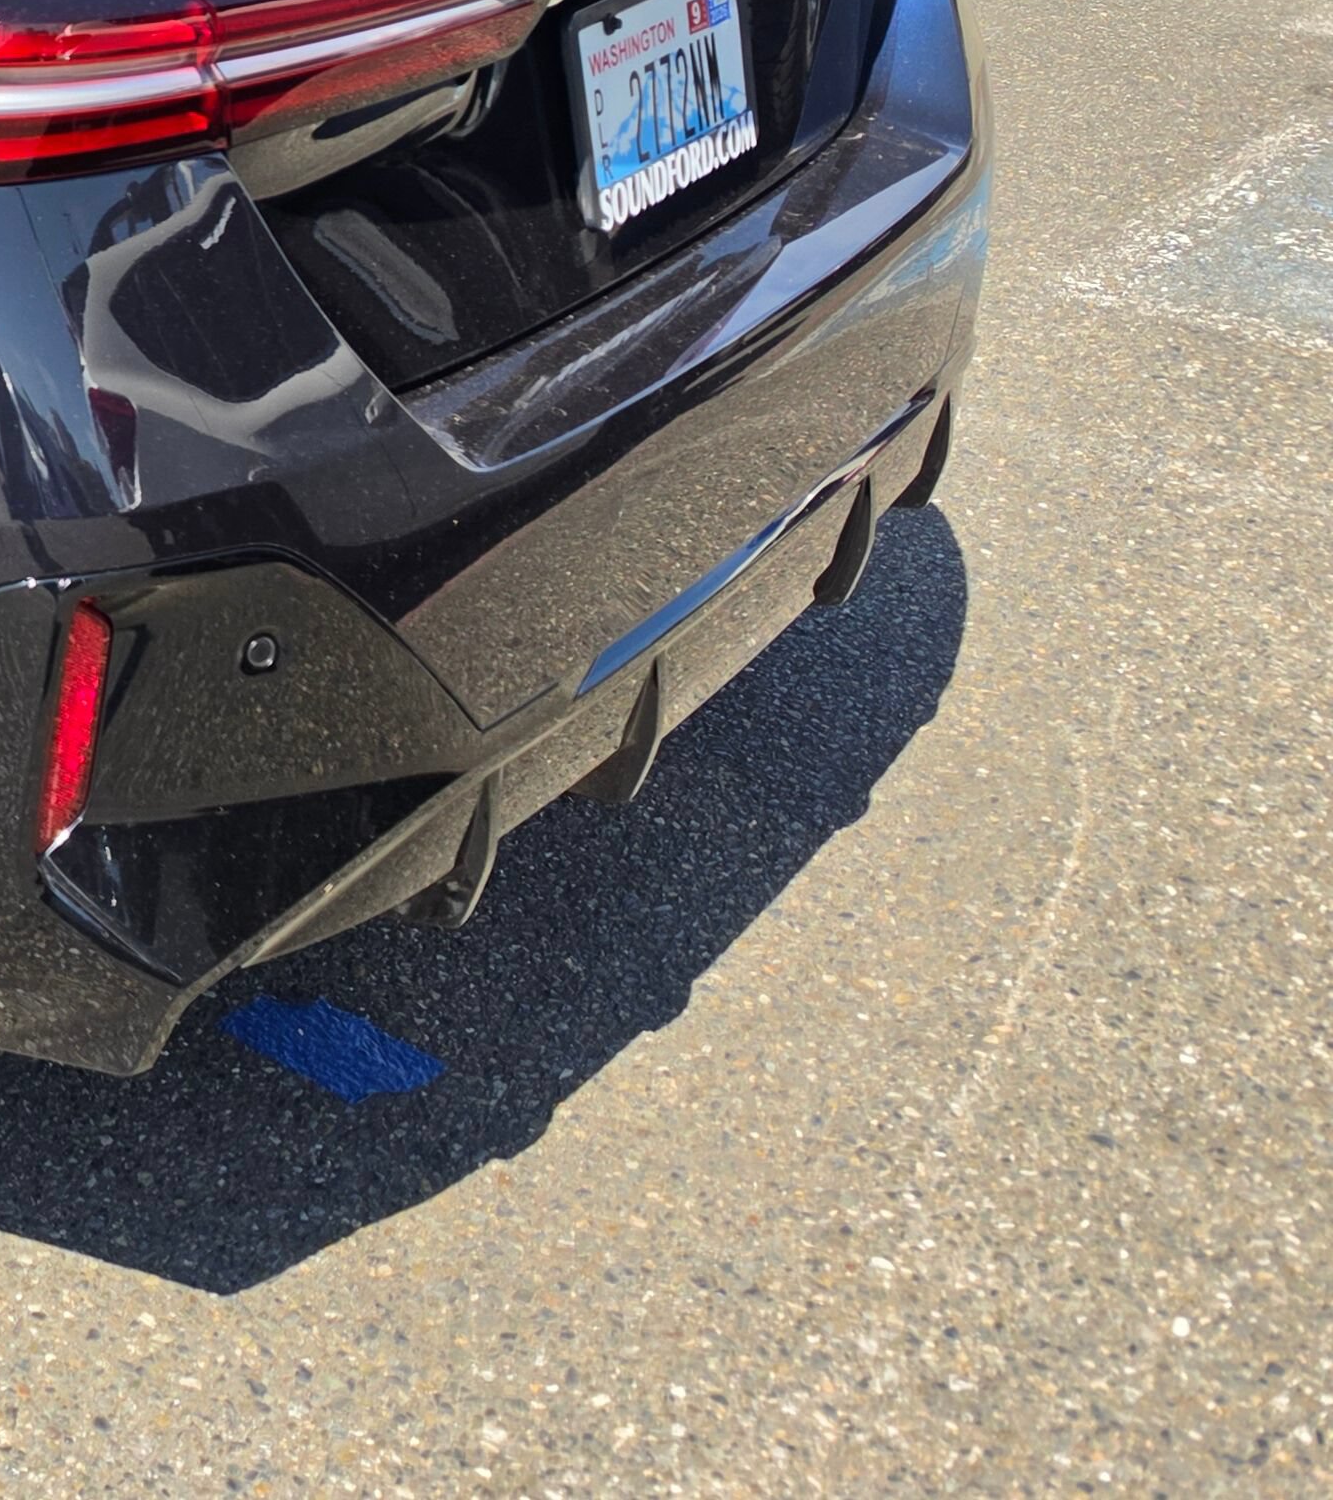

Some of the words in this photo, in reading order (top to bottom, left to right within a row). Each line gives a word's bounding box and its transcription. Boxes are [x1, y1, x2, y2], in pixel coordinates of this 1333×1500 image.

[587, 17, 676, 77] WASHINGTON
[691, 2, 701, 25] 9
[628, 32, 726, 164] 2772NM
[598, 109, 758, 232] SOUNDFORD.COM
